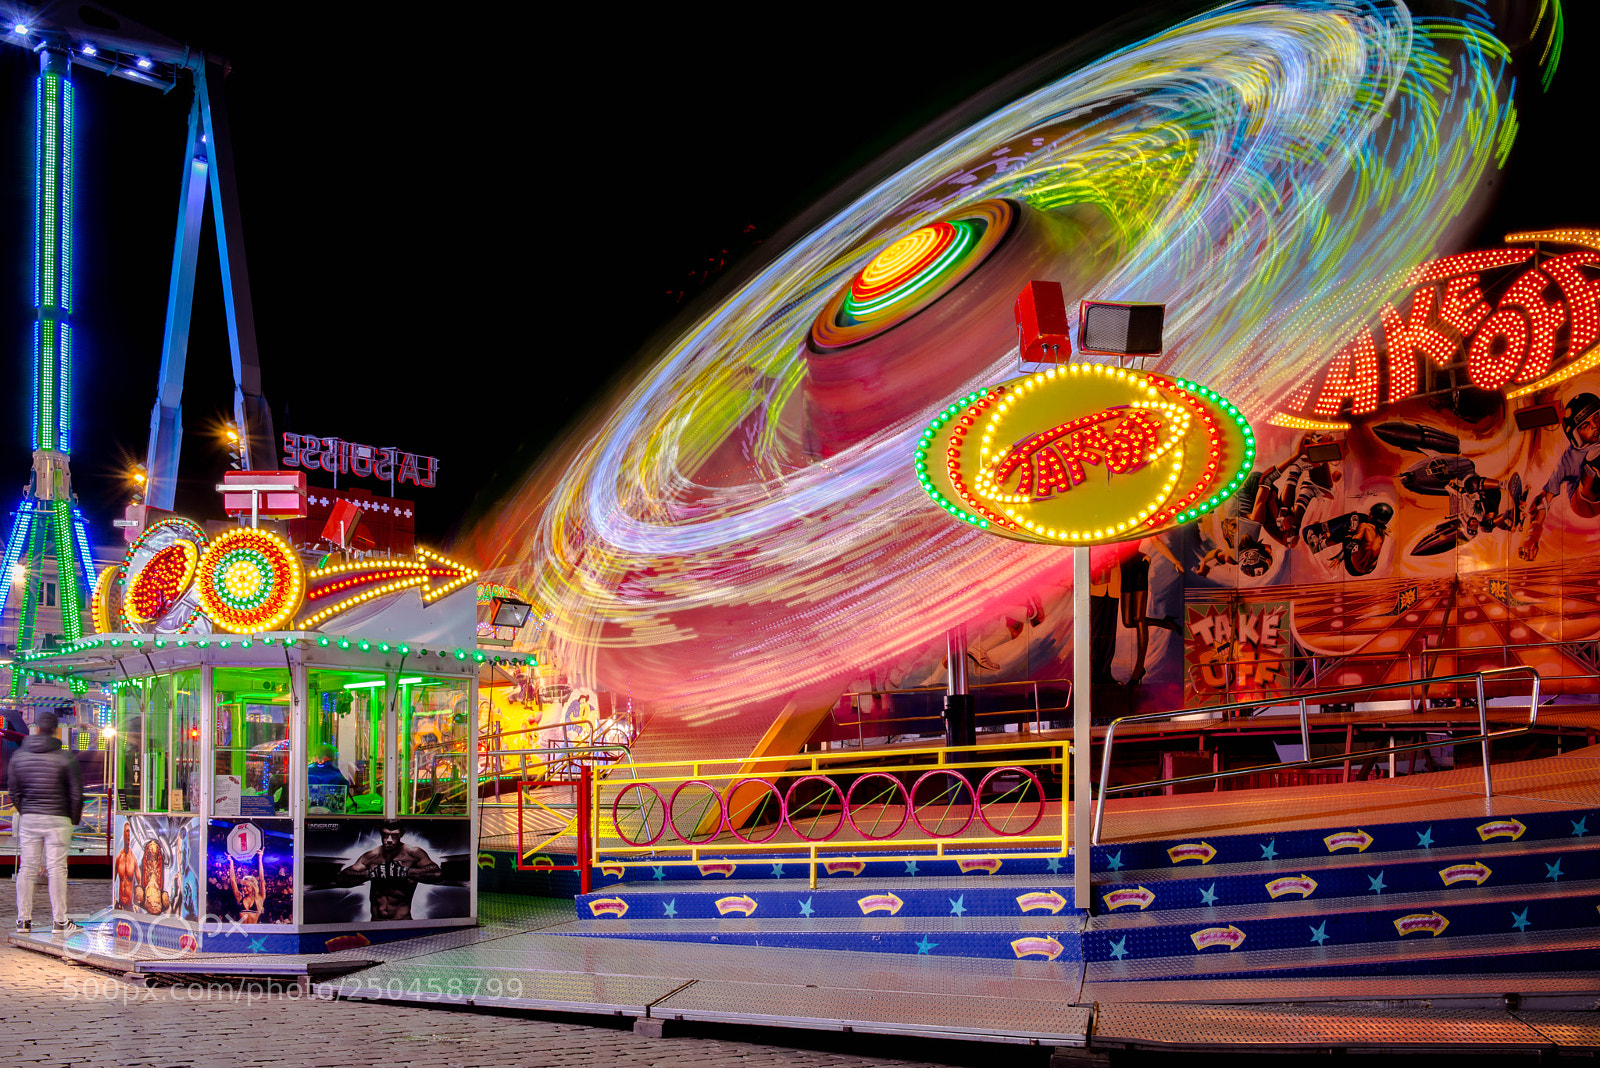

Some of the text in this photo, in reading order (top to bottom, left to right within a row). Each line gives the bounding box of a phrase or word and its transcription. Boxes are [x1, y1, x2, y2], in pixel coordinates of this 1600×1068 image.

[996, 408, 1162, 497] TAKE OFF
[1190, 606, 1284, 647] TAKE
[1199, 649, 1281, 687] OFF
[238, 832, 247, 852] 1
